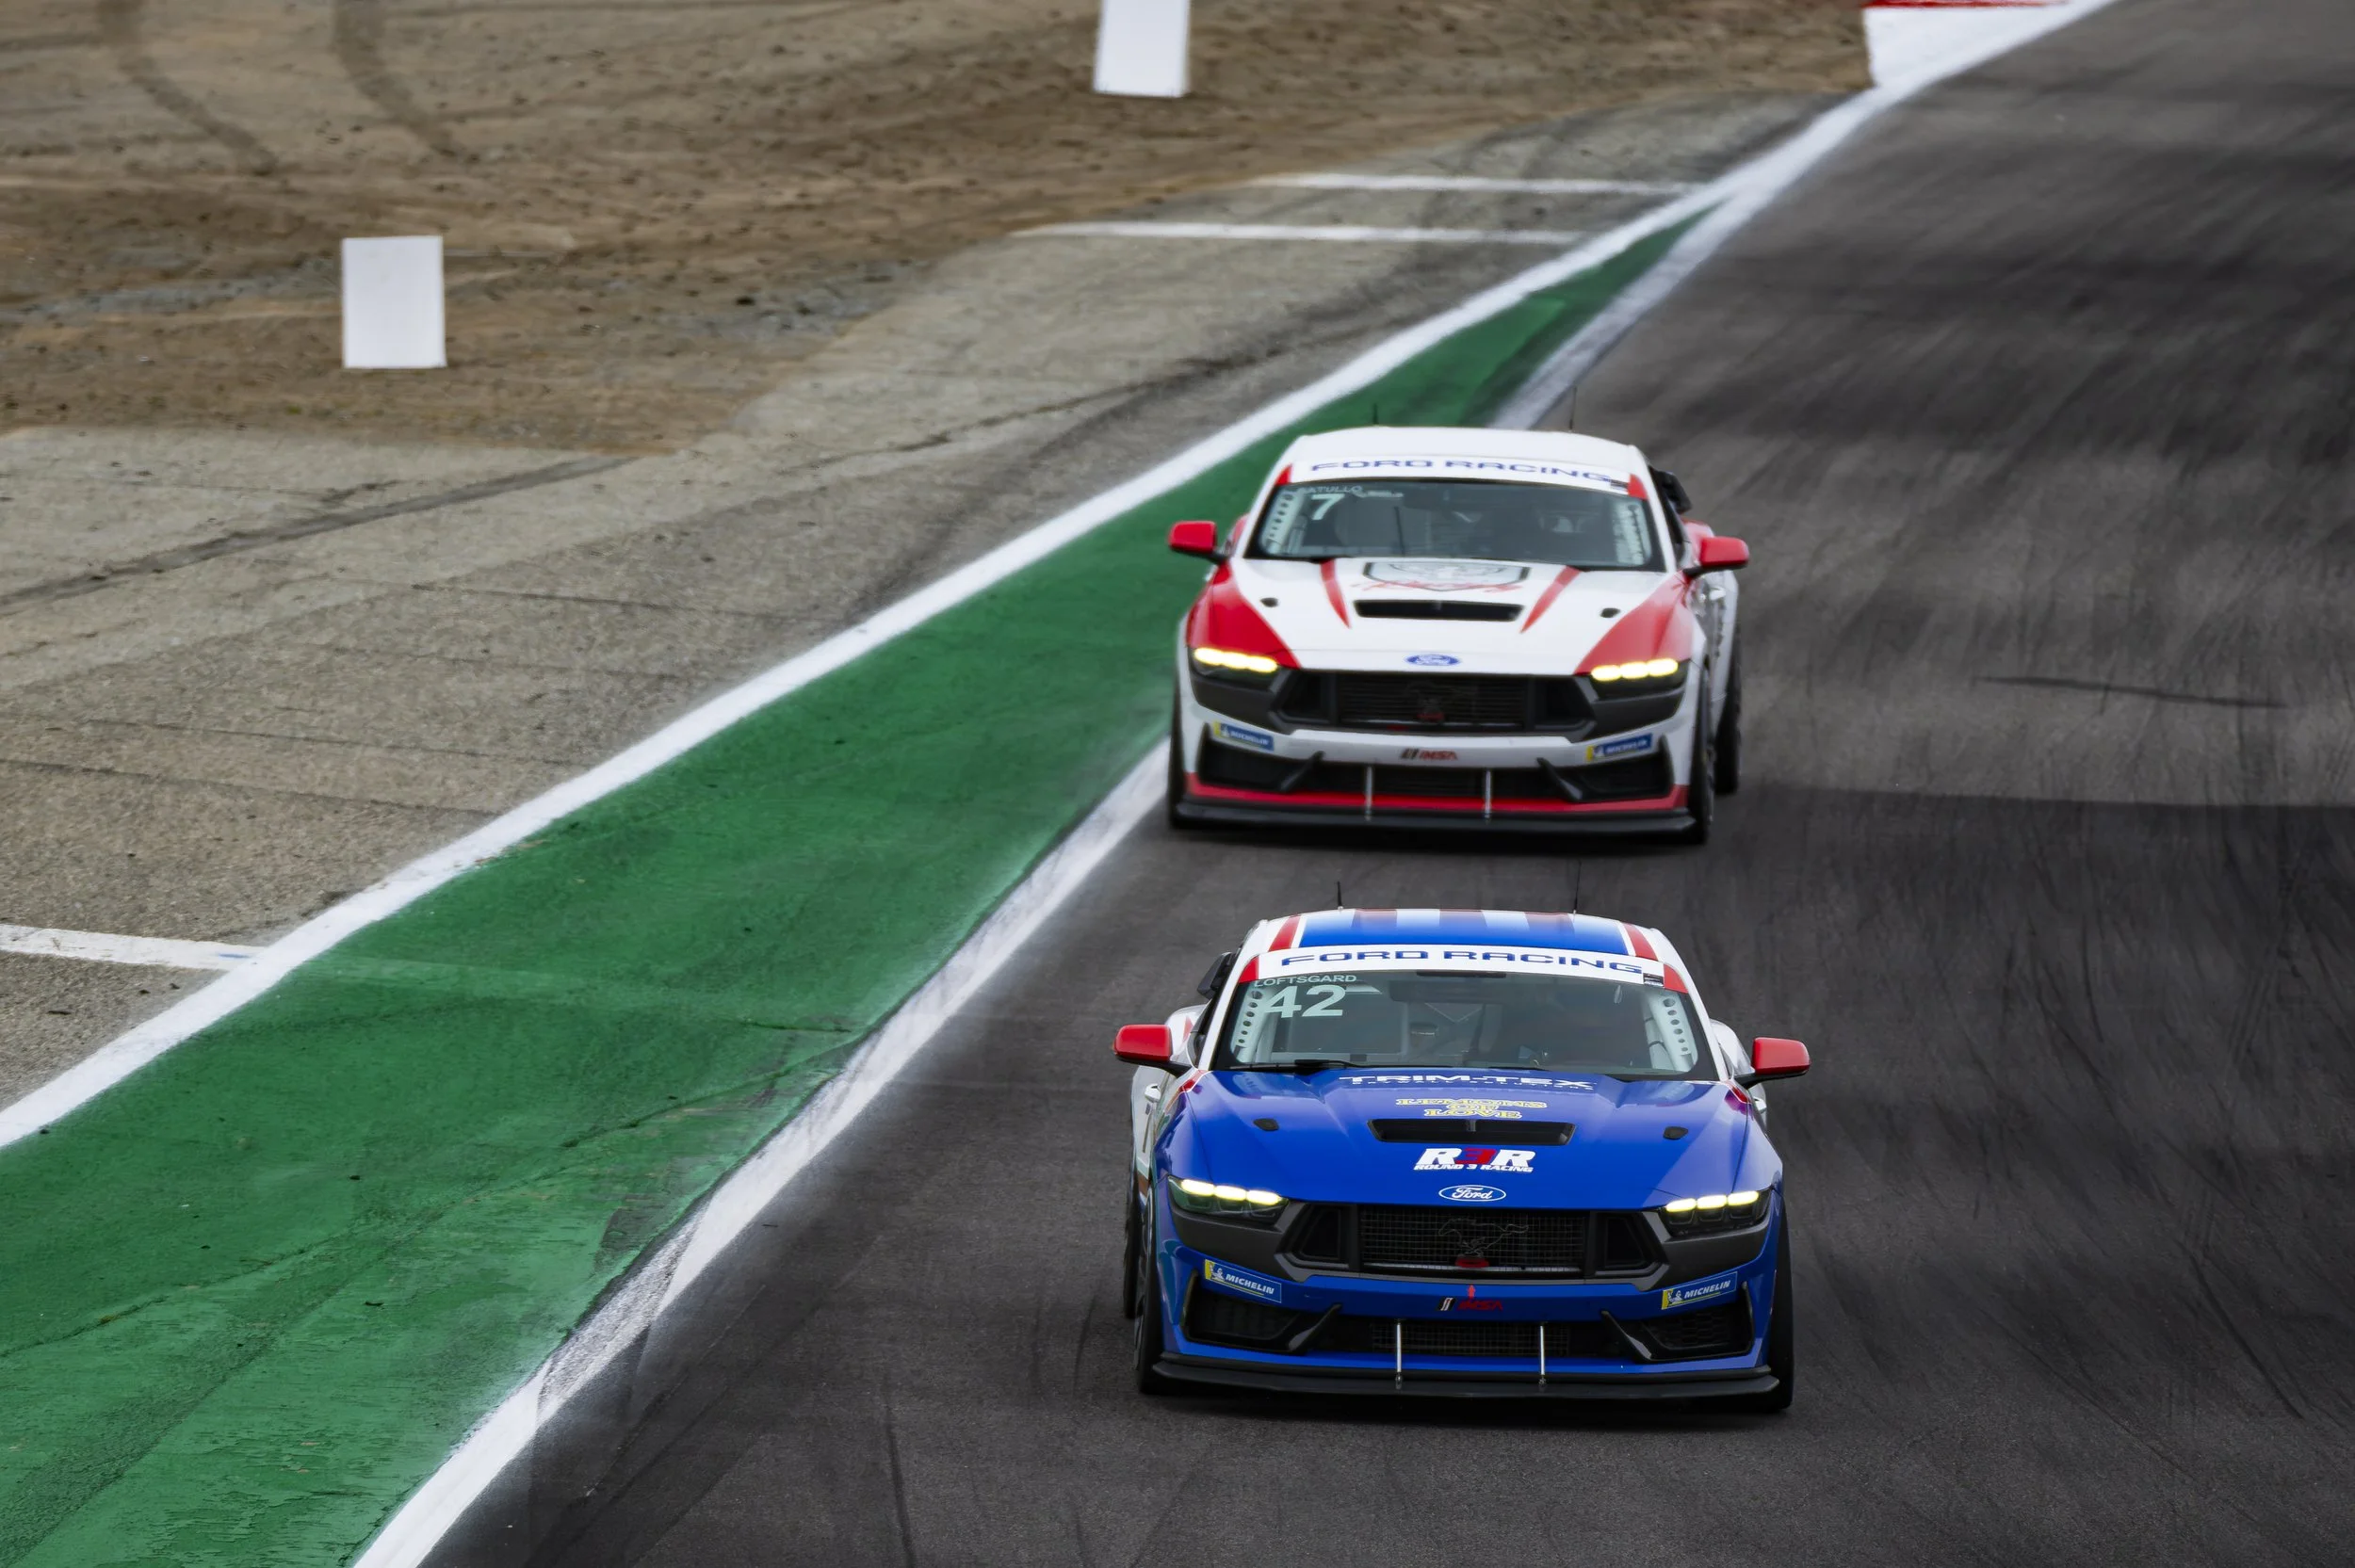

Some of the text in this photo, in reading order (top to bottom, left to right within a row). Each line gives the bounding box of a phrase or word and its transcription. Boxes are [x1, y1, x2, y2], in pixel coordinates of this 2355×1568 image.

[1311, 461, 1612, 483] FORD RACING
[1300, 485, 1363, 493] ATULLO
[1310, 493, 1346, 521] 7
[1281, 950, 1643, 975] FORD RACING
[1254, 975, 1357, 988] LOFTSGARD
[1264, 984, 1346, 1019] 42
[1339, 1075, 1594, 1089] TRIM-TEX
[1395, 1098, 1548, 1108] LEMONS
[1445, 1104, 1499, 1112] OF
[1423, 1108, 1523, 1119] LOVE
[1415, 1147, 1535, 1167] R3R
[1480, 1164, 1535, 1173] RACING
[1451, 1187, 1494, 1200] Ford
[1226, 1273, 1275, 1295] MICHELIN
[1683, 1280, 1731, 1300] MICHELIN
